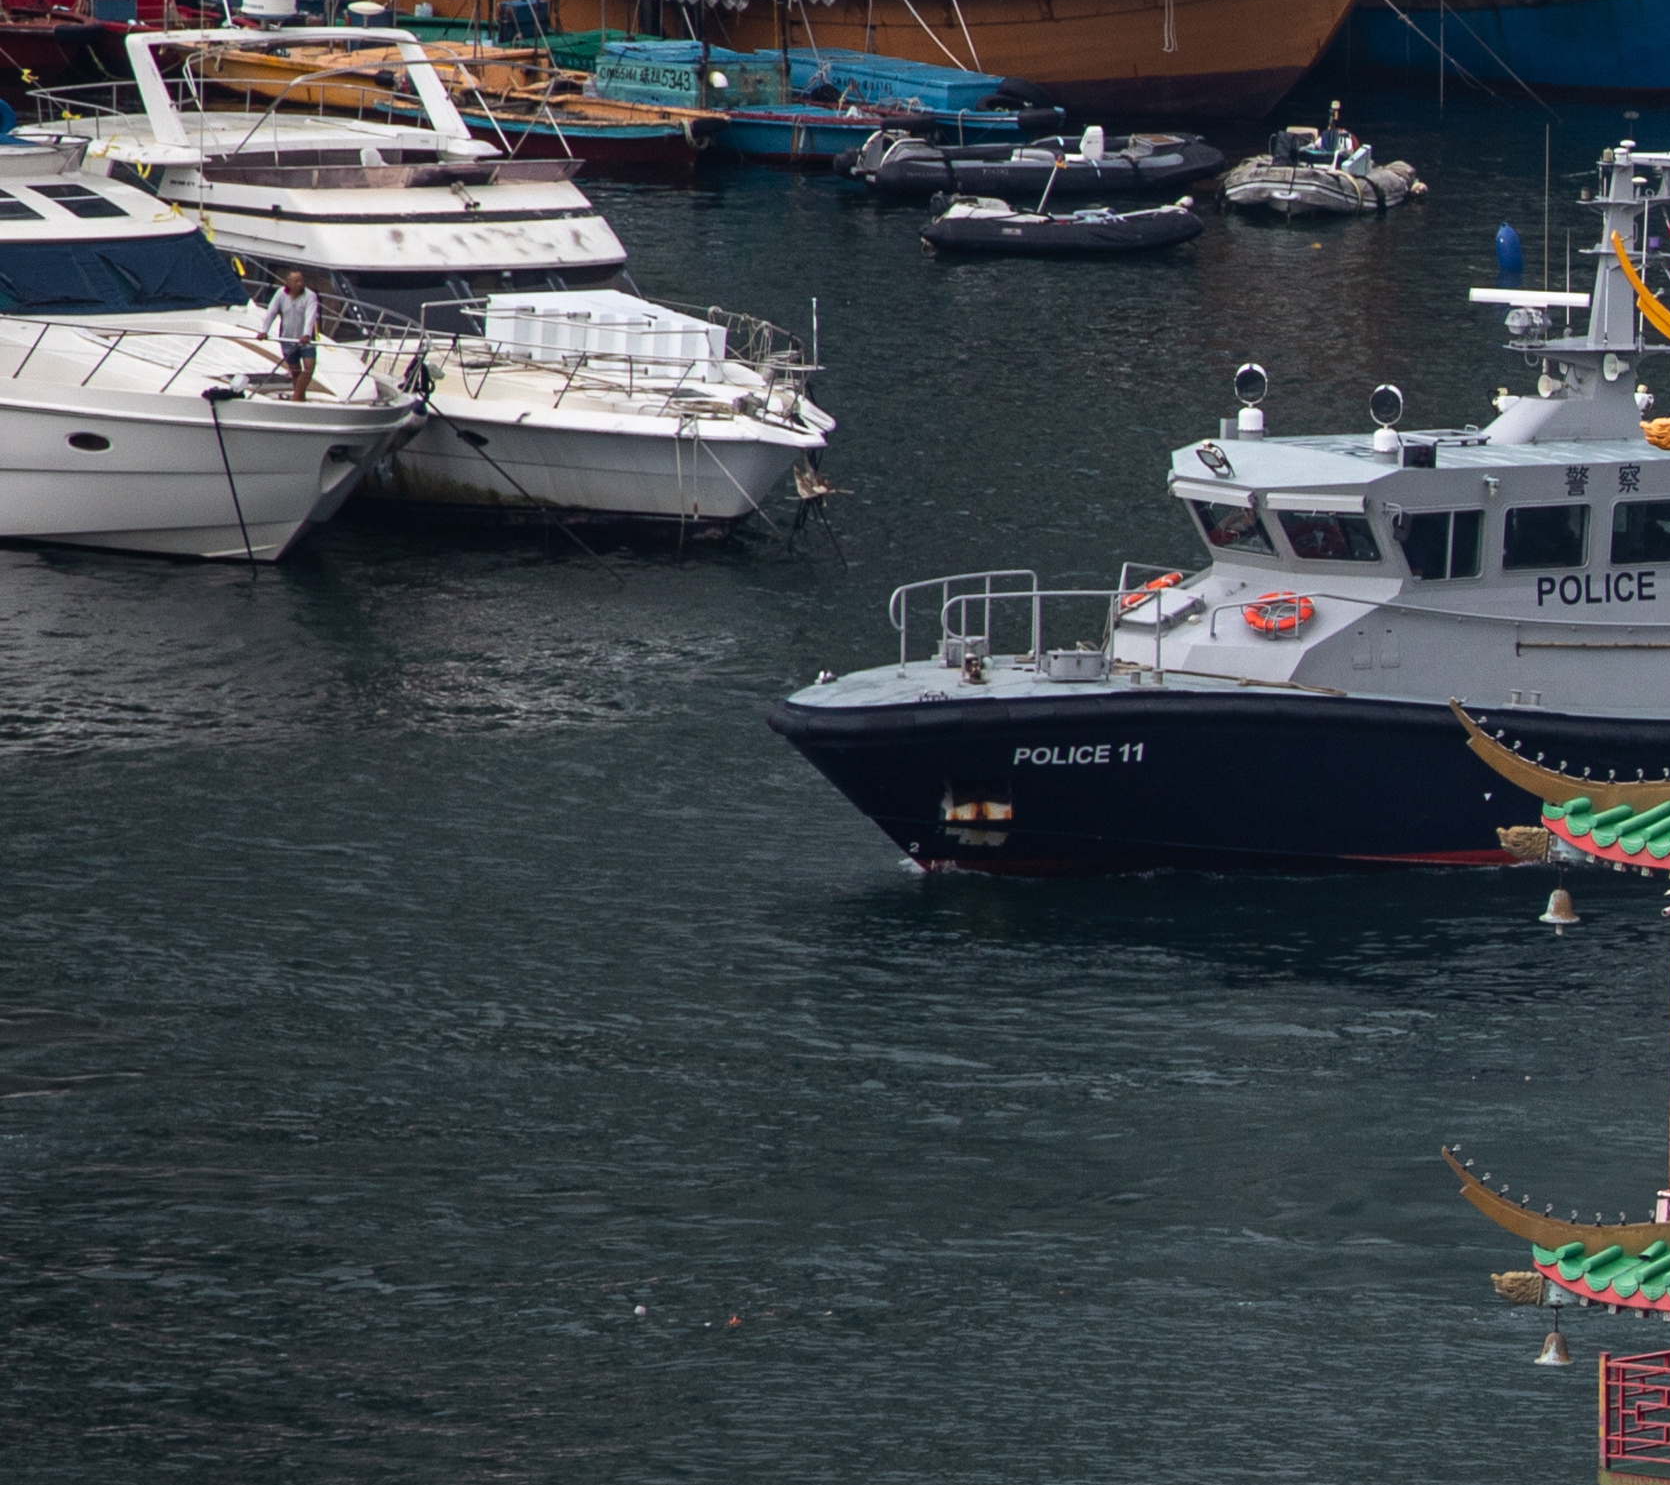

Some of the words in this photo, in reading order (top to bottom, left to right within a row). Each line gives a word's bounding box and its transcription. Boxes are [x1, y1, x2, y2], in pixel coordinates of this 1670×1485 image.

[1565, 463, 1641, 496] 警察
[1537, 571, 1656, 607] POLICE
[1013, 744, 1112, 766] POLICE
[1119, 742, 1144, 763] 11
